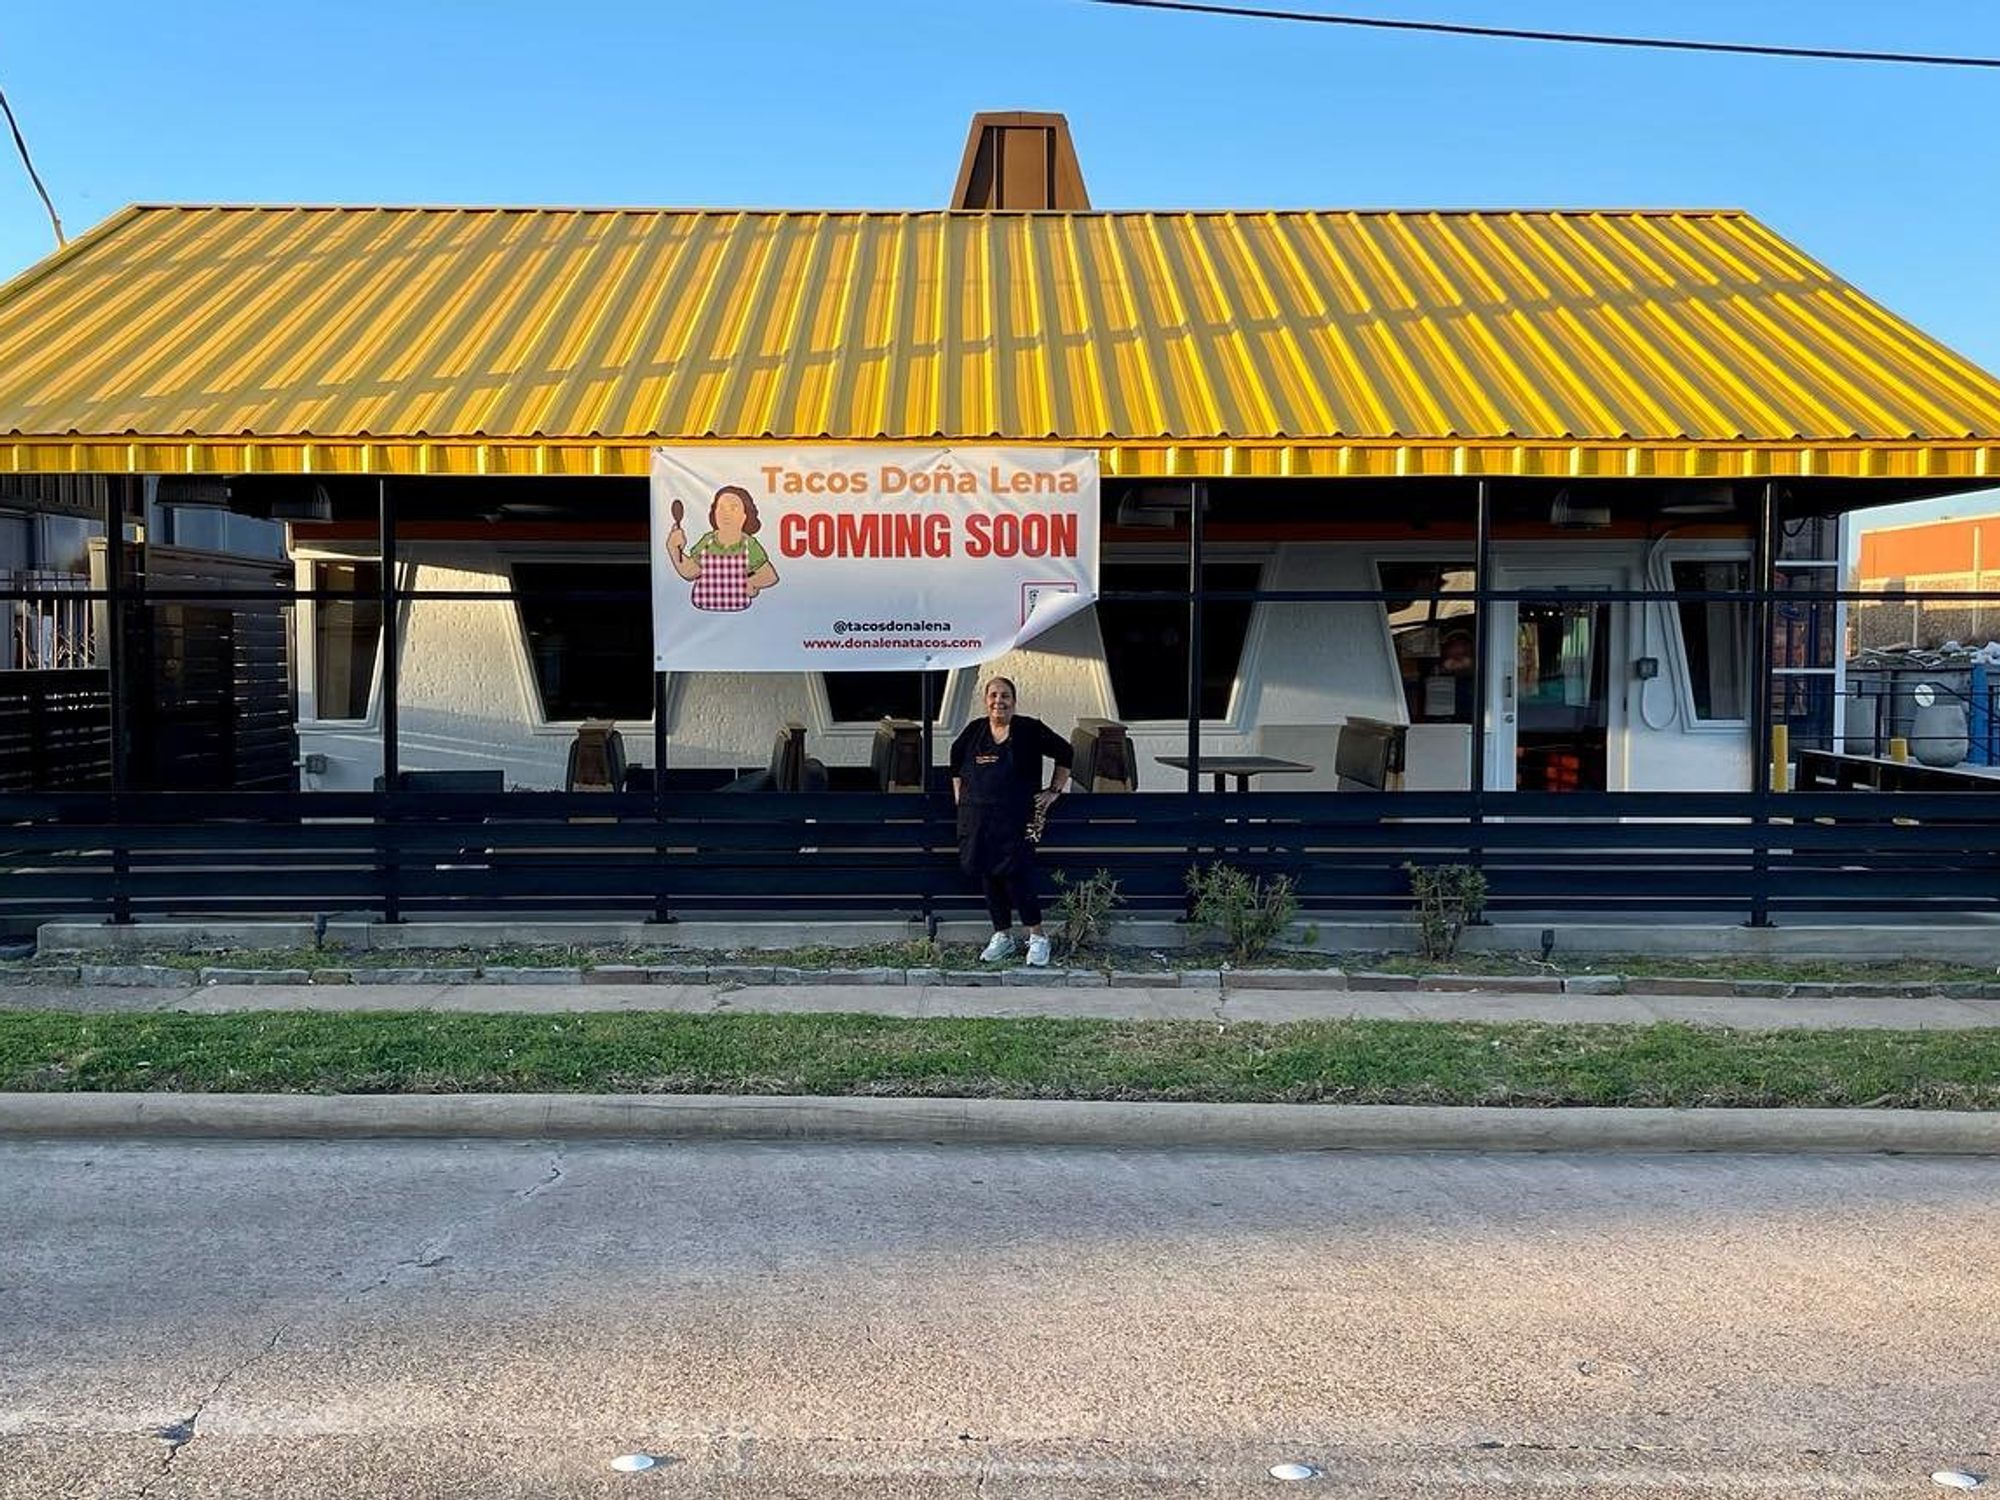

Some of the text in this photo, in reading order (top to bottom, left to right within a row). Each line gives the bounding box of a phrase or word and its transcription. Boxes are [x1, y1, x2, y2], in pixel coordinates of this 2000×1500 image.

[761, 464, 1078, 493] Tacos Doña Lena
[779, 513, 1077, 558] COMING SOON
[833, 620, 951, 633] @tacosdonalena
[803, 637, 982, 649] www.donalenatacos.com
